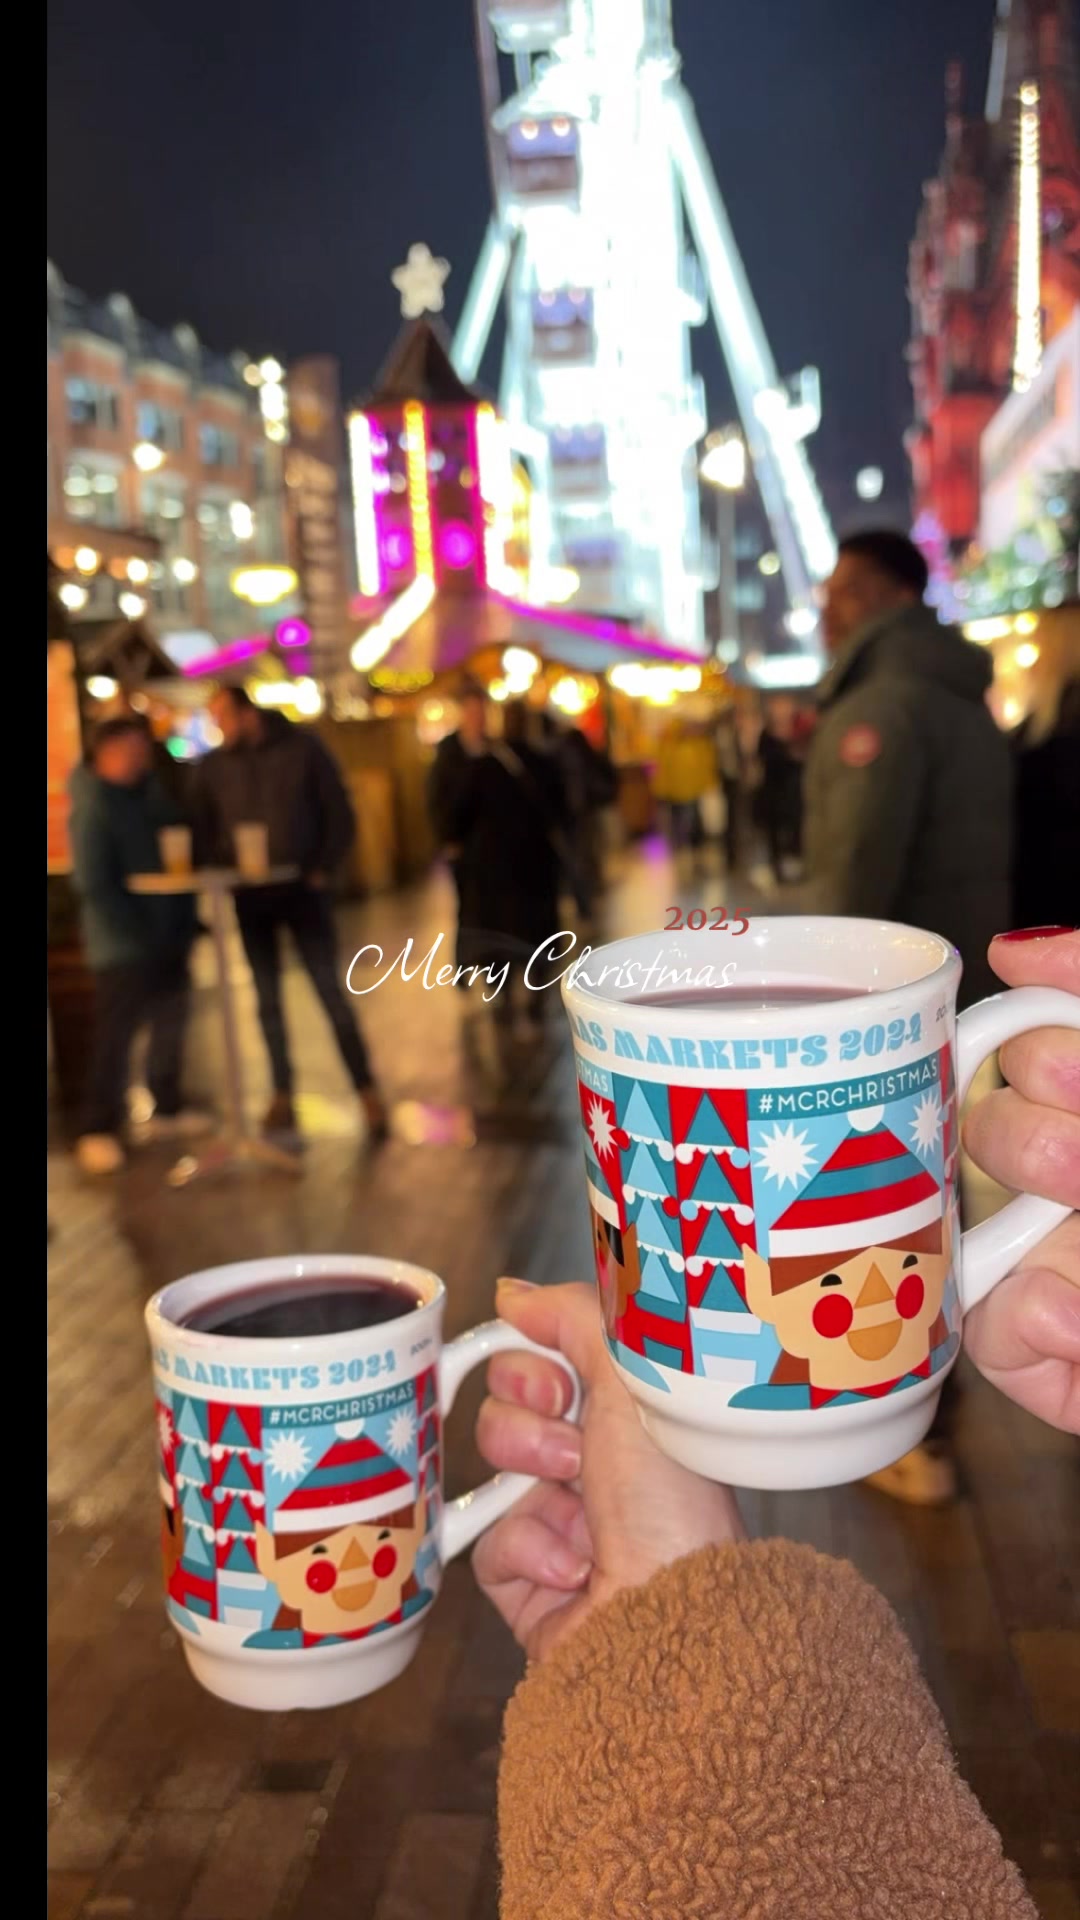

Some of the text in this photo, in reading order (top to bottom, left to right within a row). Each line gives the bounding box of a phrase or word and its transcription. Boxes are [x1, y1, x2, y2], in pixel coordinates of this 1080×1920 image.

[613, 1026, 828, 1071] MARKETS
[839, 1011, 922, 1062] 2024
[758, 1060, 939, 1114] #MCRCHRISTMAS
[174, 1353, 320, 1391] MARKETS
[327, 1348, 397, 1387] 2024
[268, 1381, 414, 1424] #MCRCHRISTMAS
